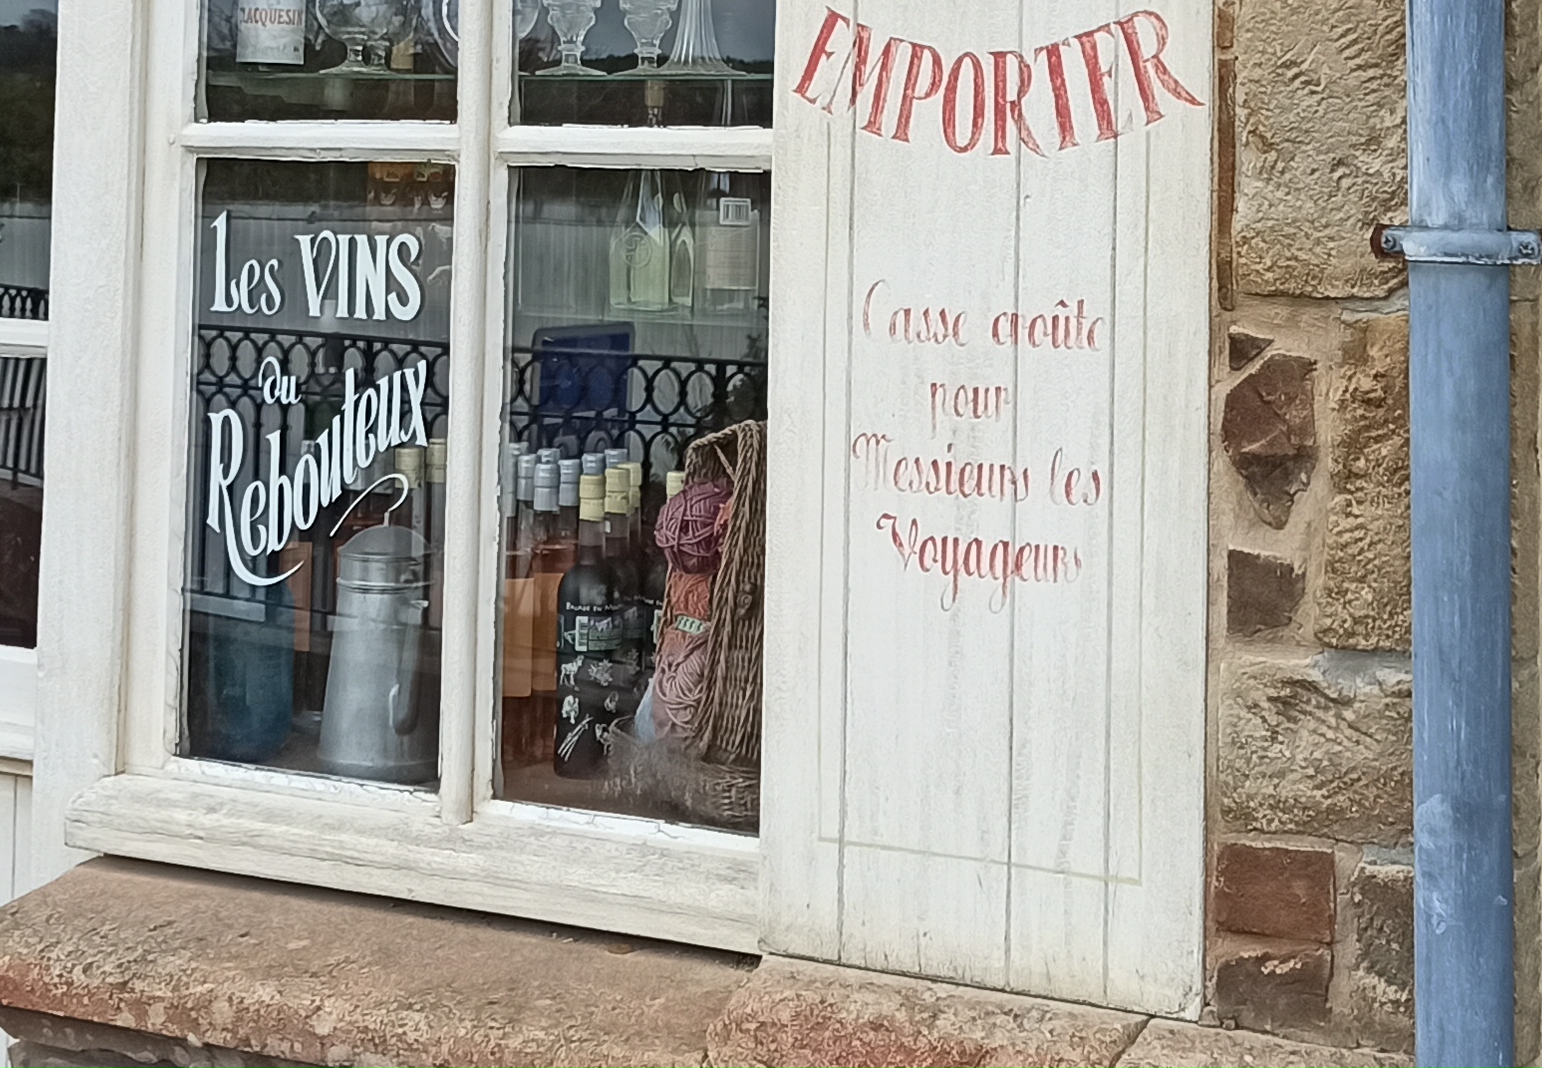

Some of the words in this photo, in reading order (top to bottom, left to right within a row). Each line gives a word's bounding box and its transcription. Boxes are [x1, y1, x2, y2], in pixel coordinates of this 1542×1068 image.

[792, 5, 1207, 159] EMPORTER
[209, 210, 283, 316] Les
[293, 229, 422, 322] VINS
[862, 278, 970, 348] Casse
[991, 297, 1106, 352] croûte
[259, 356, 302, 406] du
[930, 382, 1012, 439] pour
[206, 359, 429, 586] Rebouteux
[852, 432, 1030, 504] Messieurs
[1049, 446, 1101, 507] les
[876, 512, 1083, 614] Voyageurs
